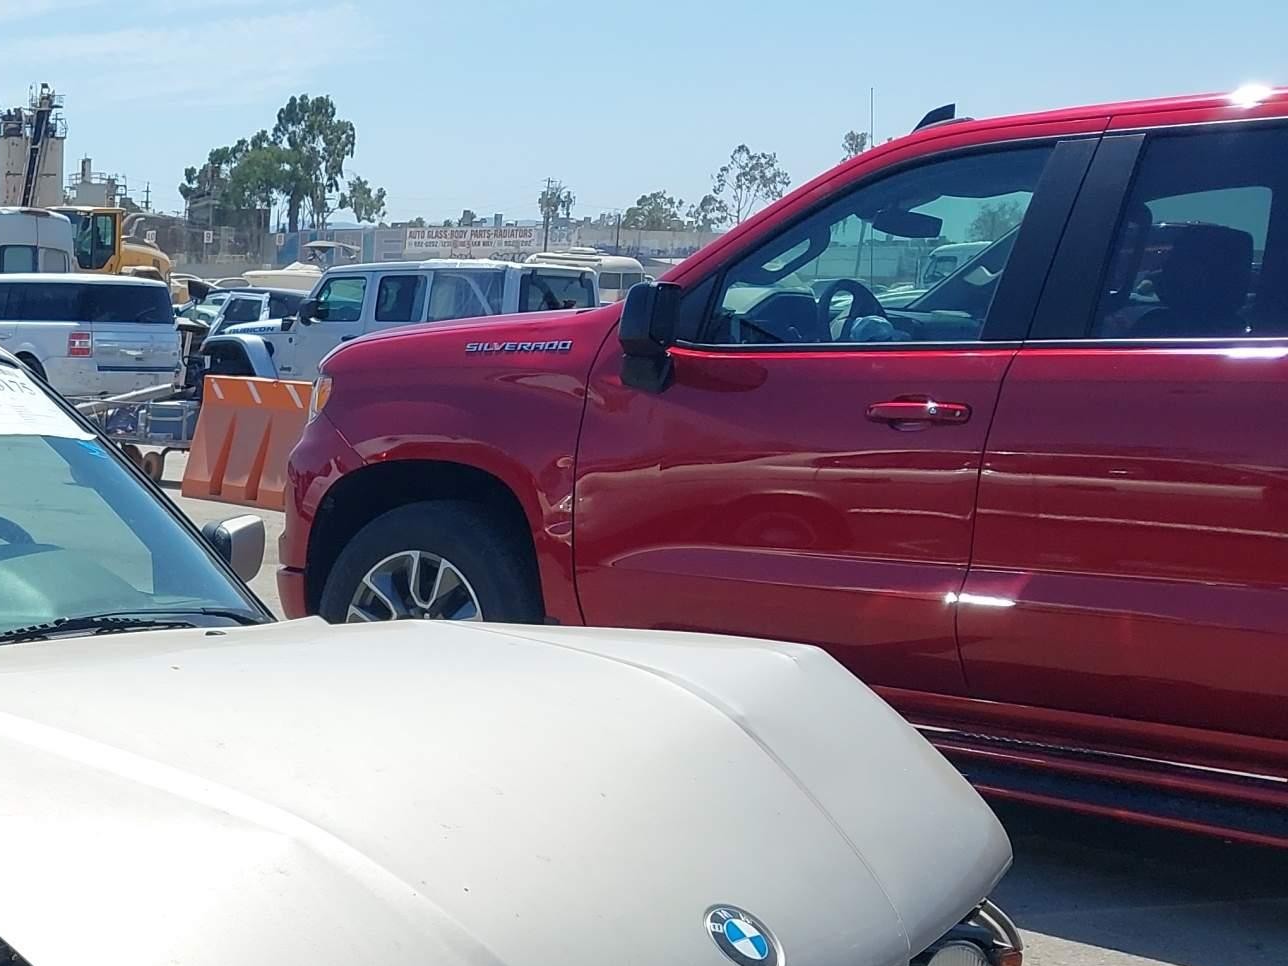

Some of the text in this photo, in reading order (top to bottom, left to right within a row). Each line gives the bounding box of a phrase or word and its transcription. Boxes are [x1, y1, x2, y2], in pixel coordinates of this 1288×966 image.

[408, 230, 425, 240] AUTO
[465, 340, 573, 352] SILVERADO
[711, 909, 753, 932] BMW
